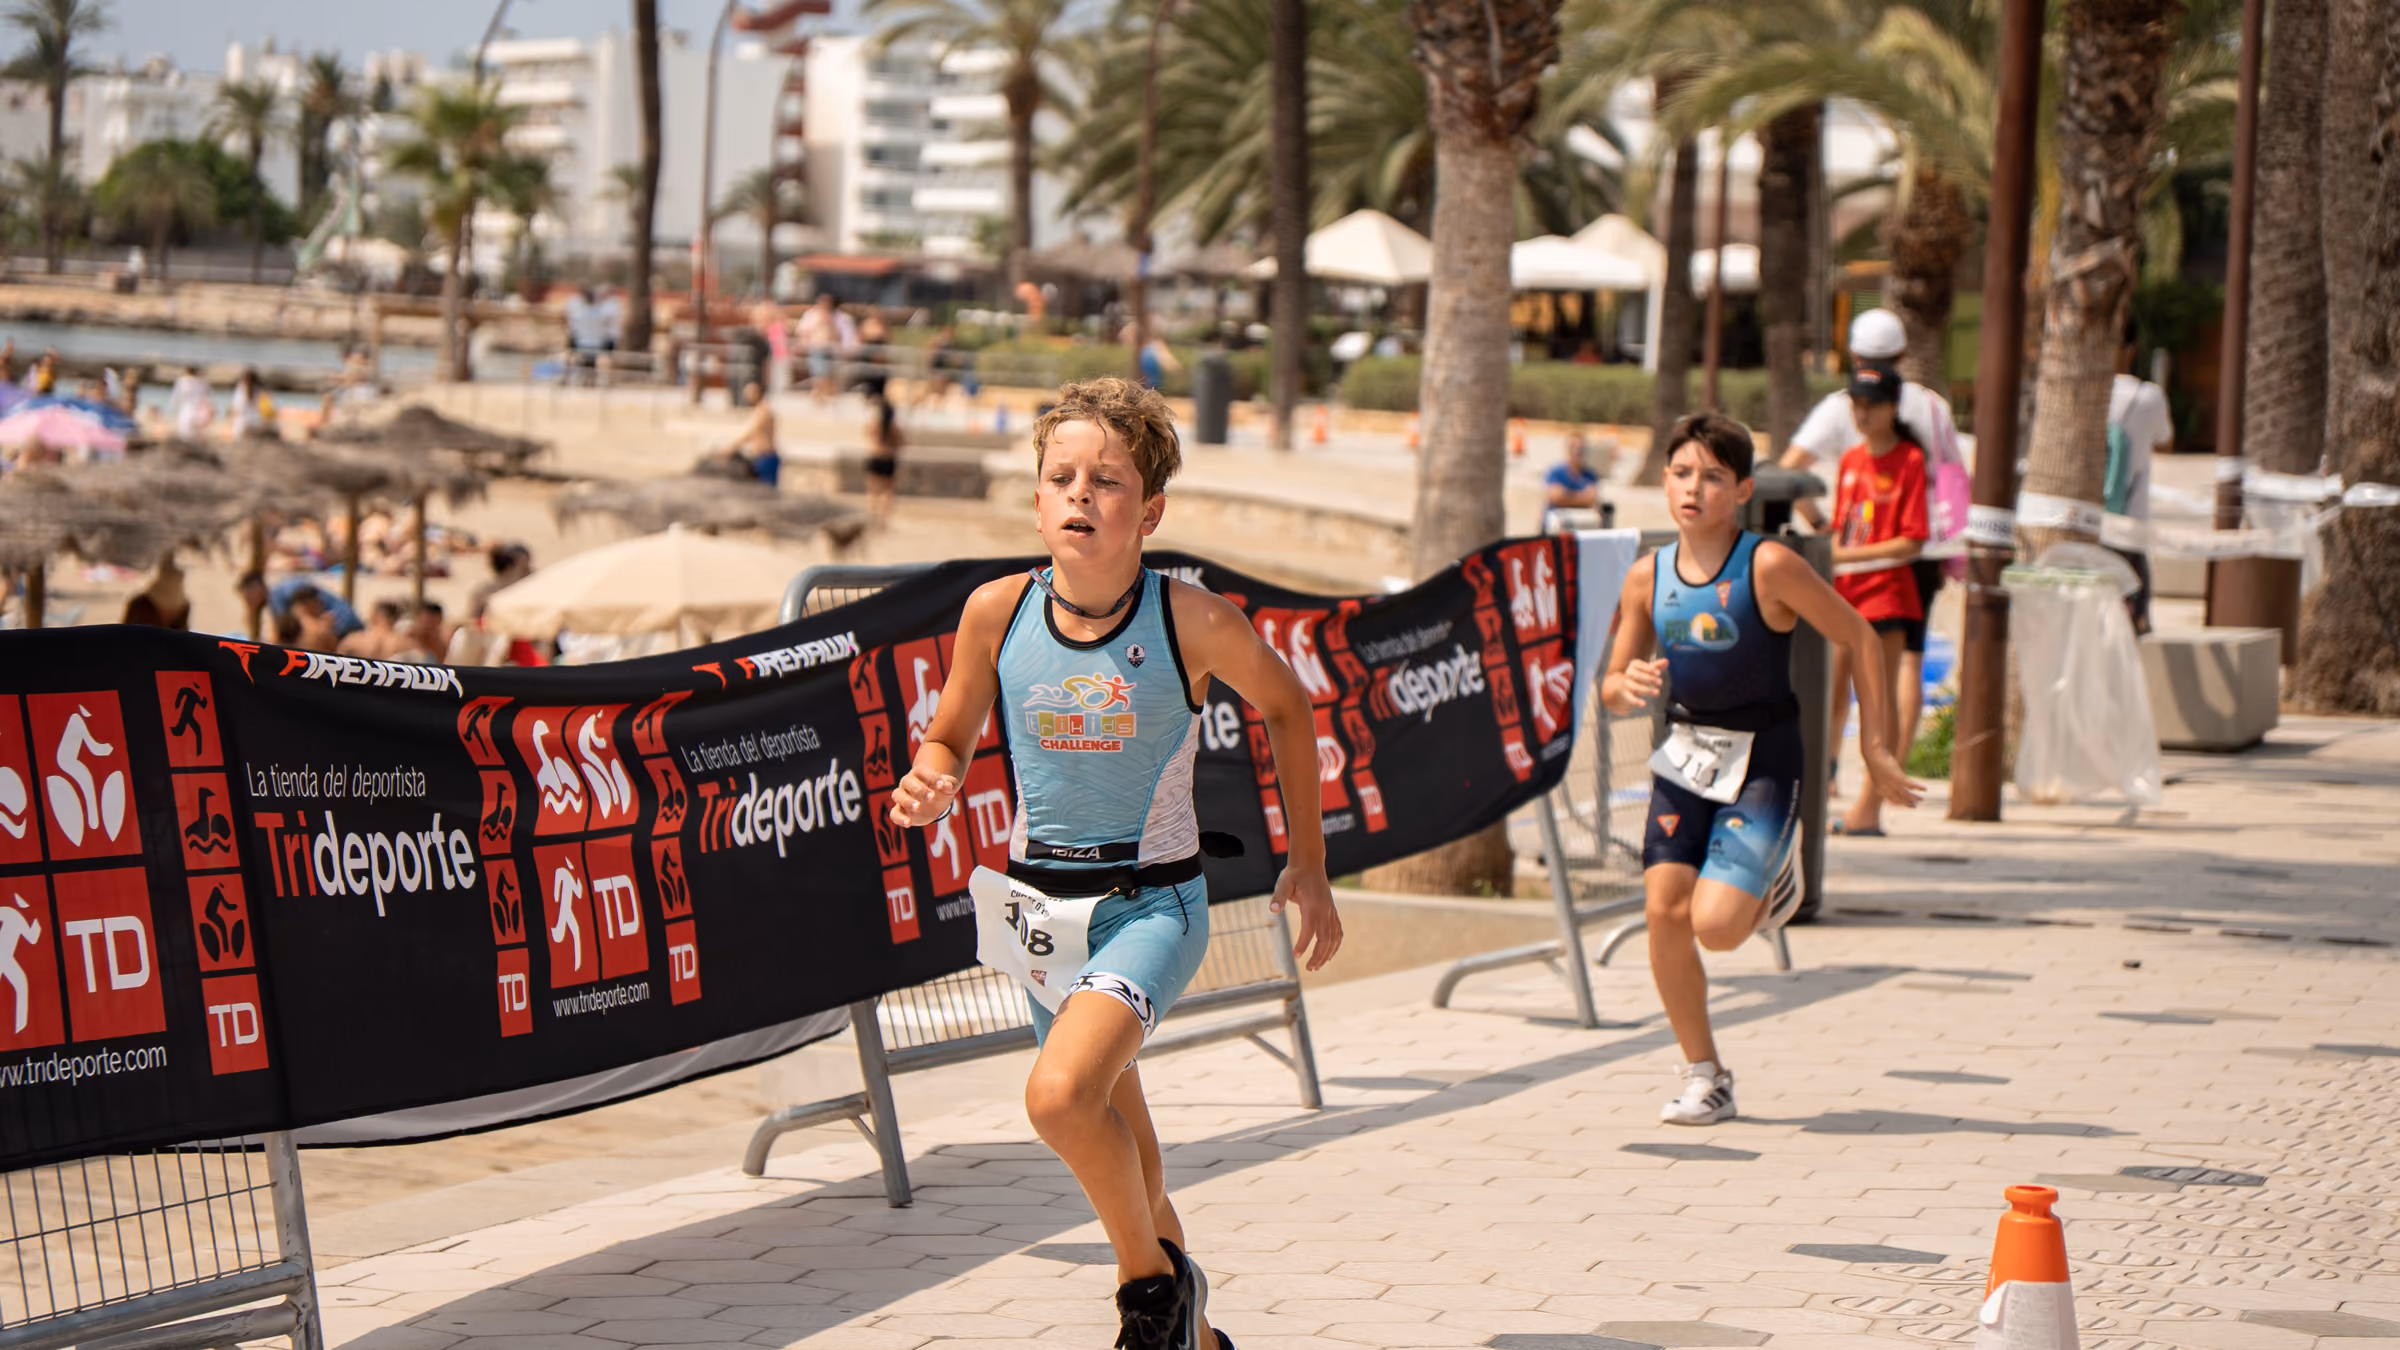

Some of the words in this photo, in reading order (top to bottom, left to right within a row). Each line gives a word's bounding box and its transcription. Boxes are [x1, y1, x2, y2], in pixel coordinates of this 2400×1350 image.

[278, 649, 463, 698] FIREHAWK
[733, 631, 861, 679] FIREHAWK
[680, 745, 704, 773] La
[698, 738, 741, 771] tienda
[739, 732, 760, 763] del
[759, 724, 821, 762] deportista
[1040, 739, 1121, 751] CHALLENGE
[246, 762, 268, 797] La
[270, 763, 319, 798] tienda
[323, 764, 347, 798] del
[352, 764, 426, 805] deportista
[697, 757, 862, 858] Trideporte
[968, 788, 1011, 848] TD
[254, 810, 476, 917] Trideporte
[593, 874, 640, 939] TD
[887, 887, 914, 923] TD
[1004, 902, 1055, 956] 108
[65, 915, 151, 993] TD
[669, 943, 696, 982] TD
[498, 973, 527, 1012] TD
[552, 982, 650, 1018] www.trideporte.com
[208, 1002, 259, 1047] TD
